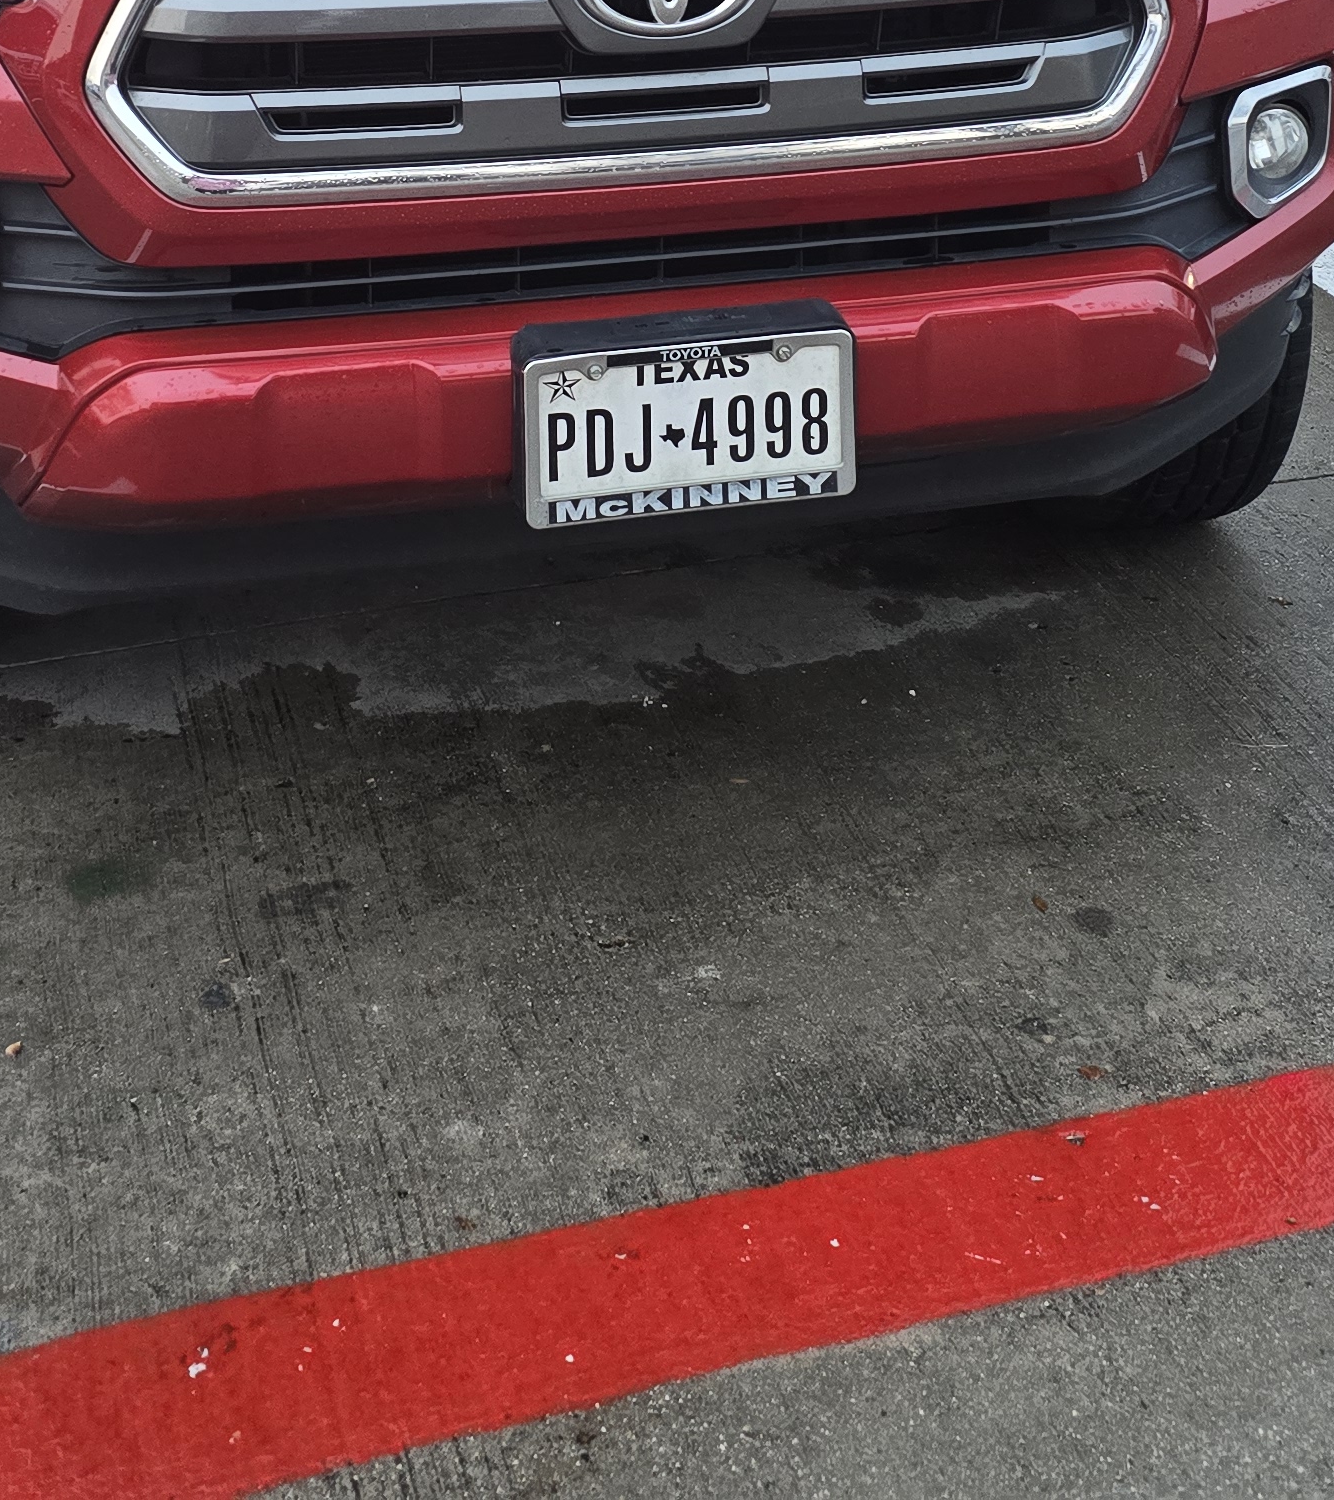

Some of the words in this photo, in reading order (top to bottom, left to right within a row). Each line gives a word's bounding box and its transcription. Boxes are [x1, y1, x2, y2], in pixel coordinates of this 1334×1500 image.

[660, 345, 722, 362] TOYOTA
[635, 354, 750, 386] TEXAS
[555, 471, 834, 523] McKINNEY
